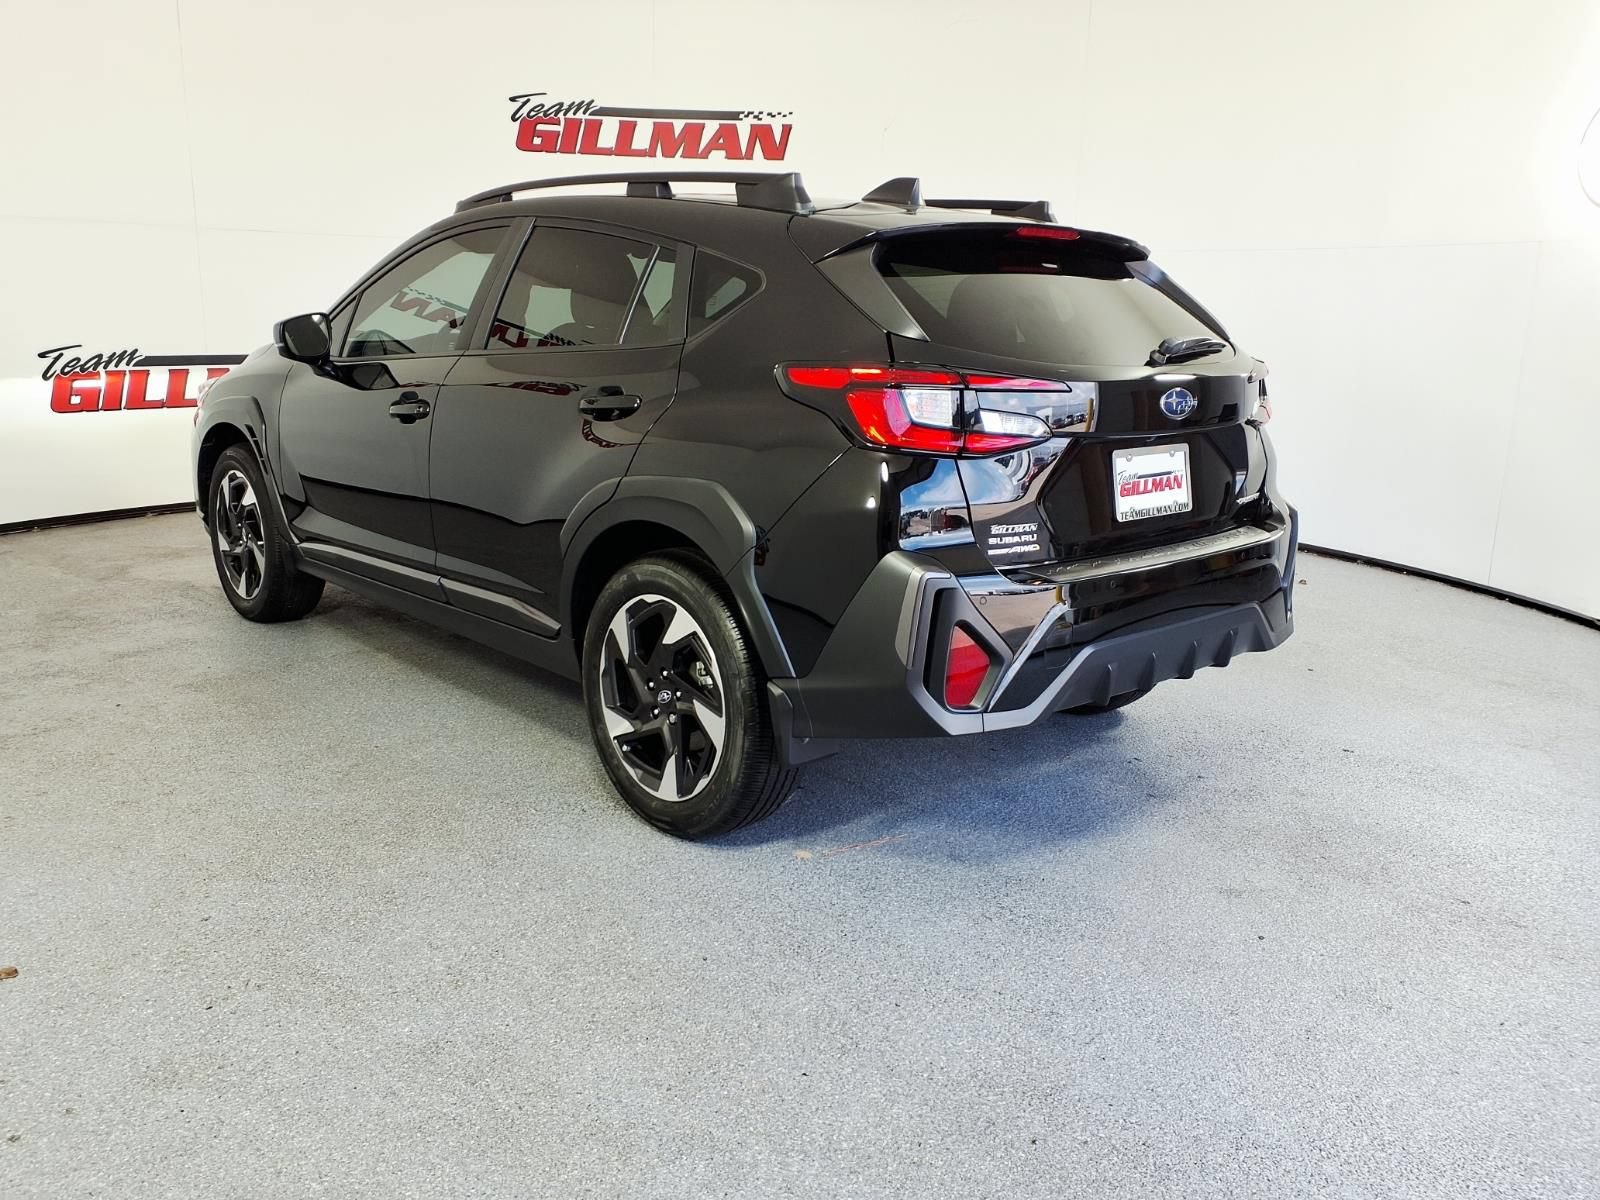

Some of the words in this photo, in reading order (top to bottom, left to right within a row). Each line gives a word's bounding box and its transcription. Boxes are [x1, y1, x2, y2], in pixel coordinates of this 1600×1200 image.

[508, 92, 598, 122] Team
[515, 116, 793, 160] GILLMAN
[37, 344, 143, 381] Team
[50, 367, 231, 413] GILL
[1119, 474, 1184, 498] GILLMAN
[1120, 502, 1190, 521] TEAMGILLMAN.COM
[988, 534, 1038, 545] SUBARU
[1008, 544, 1040, 554] AWD
